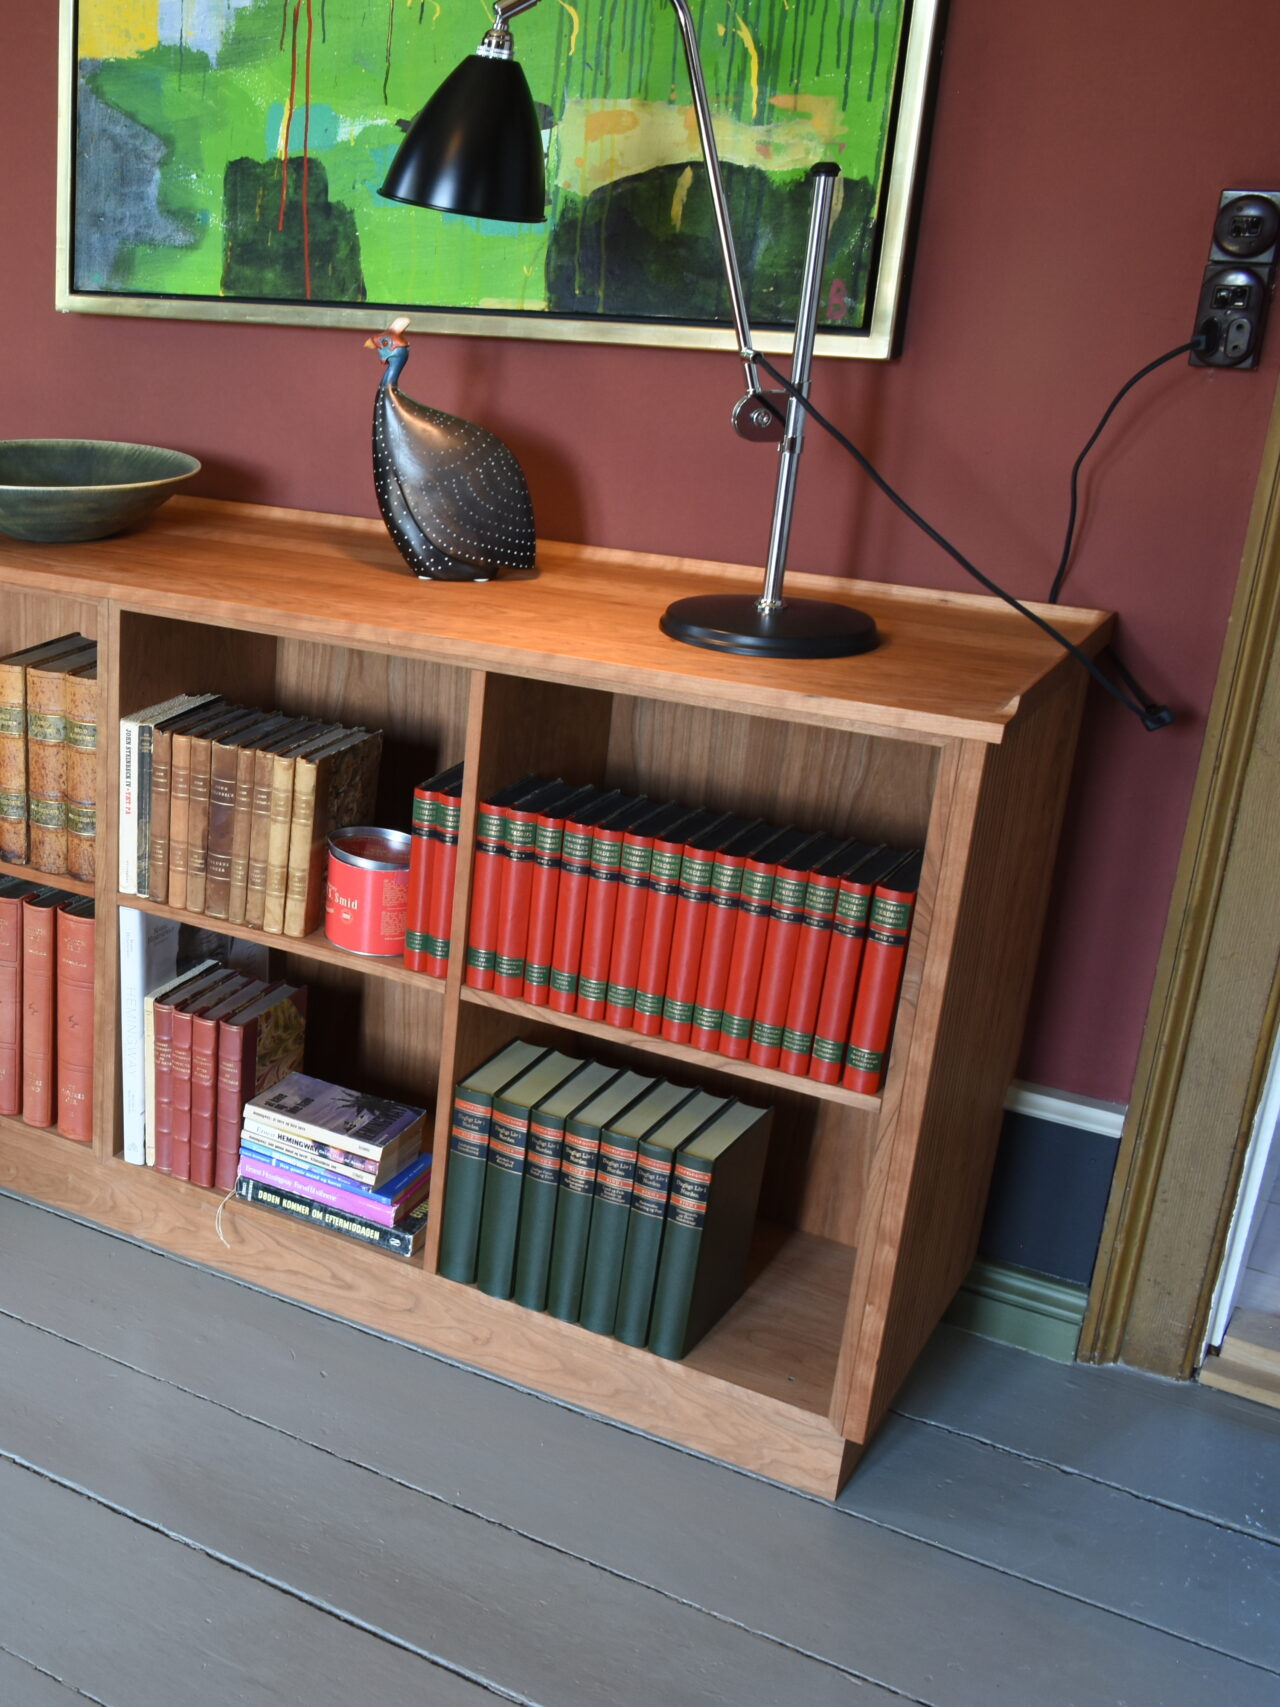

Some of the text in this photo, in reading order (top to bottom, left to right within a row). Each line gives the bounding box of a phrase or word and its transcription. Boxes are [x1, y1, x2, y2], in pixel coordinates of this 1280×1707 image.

[335, 893, 358, 910] Smid
[126, 985, 139, 1077] HEMINGWAY
[277, 1133, 319, 1153] HEMINGWAY
[263, 1171, 292, 1187] Hemingway
[258, 1190, 380, 1241] DØDEN KOMMER OM EFTERMIDDAGEN
